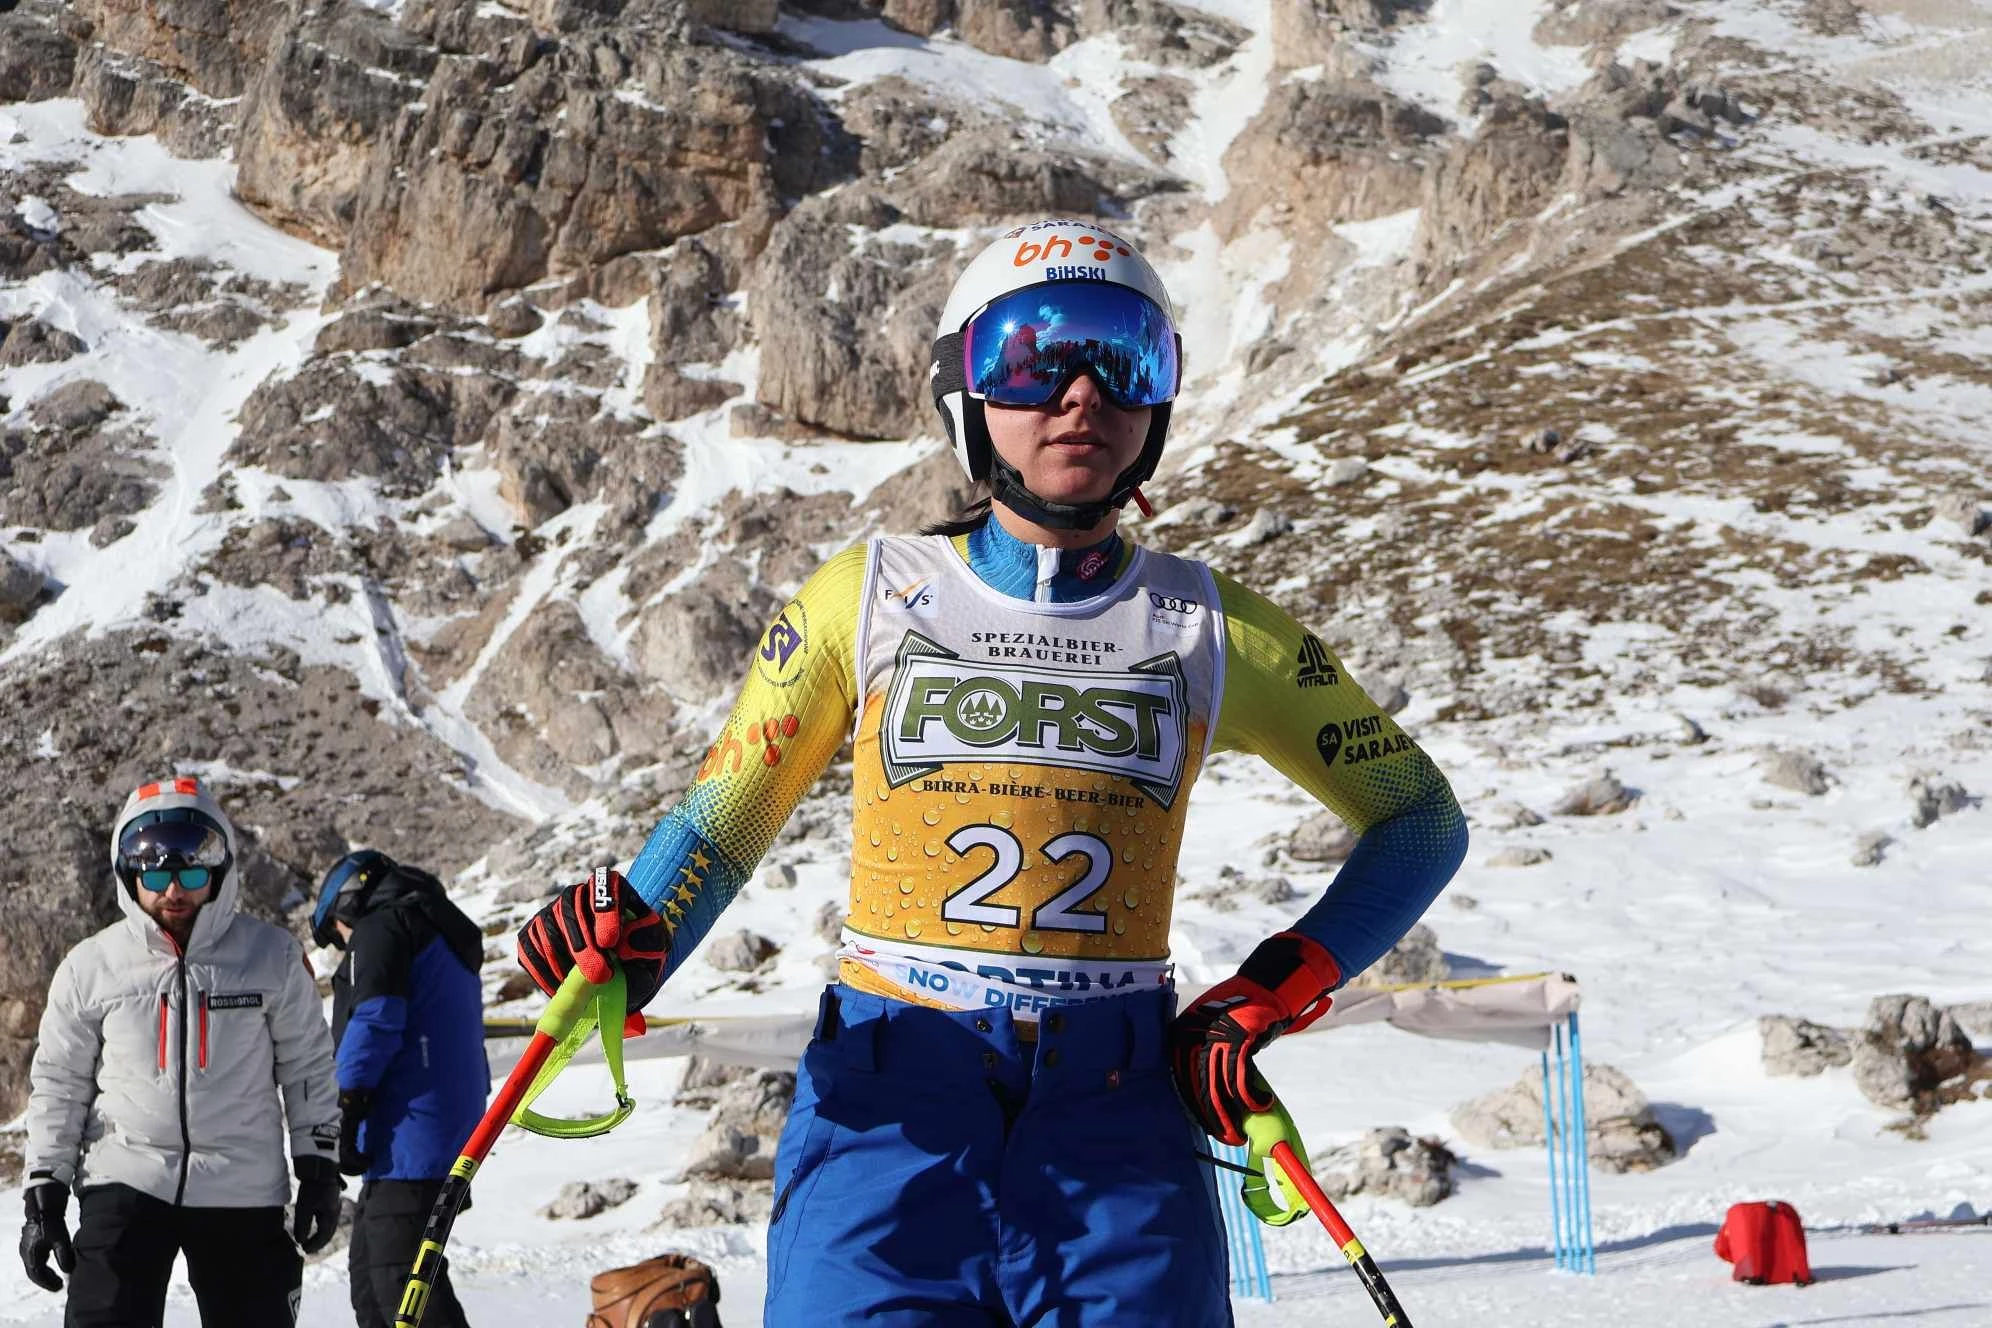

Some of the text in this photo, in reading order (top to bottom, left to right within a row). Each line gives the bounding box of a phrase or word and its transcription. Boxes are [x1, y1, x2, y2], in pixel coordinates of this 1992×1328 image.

[1014, 235, 1072, 267] bh
[971, 631, 1123, 652] SPEZIALBIER-
[988, 646, 1102, 665] BRAUEREI
[899, 676, 1171, 762] FORST
[1343, 715, 1383, 740] VISIT
[1321, 733, 1338, 746] SA
[941, 823, 1114, 934] 22
